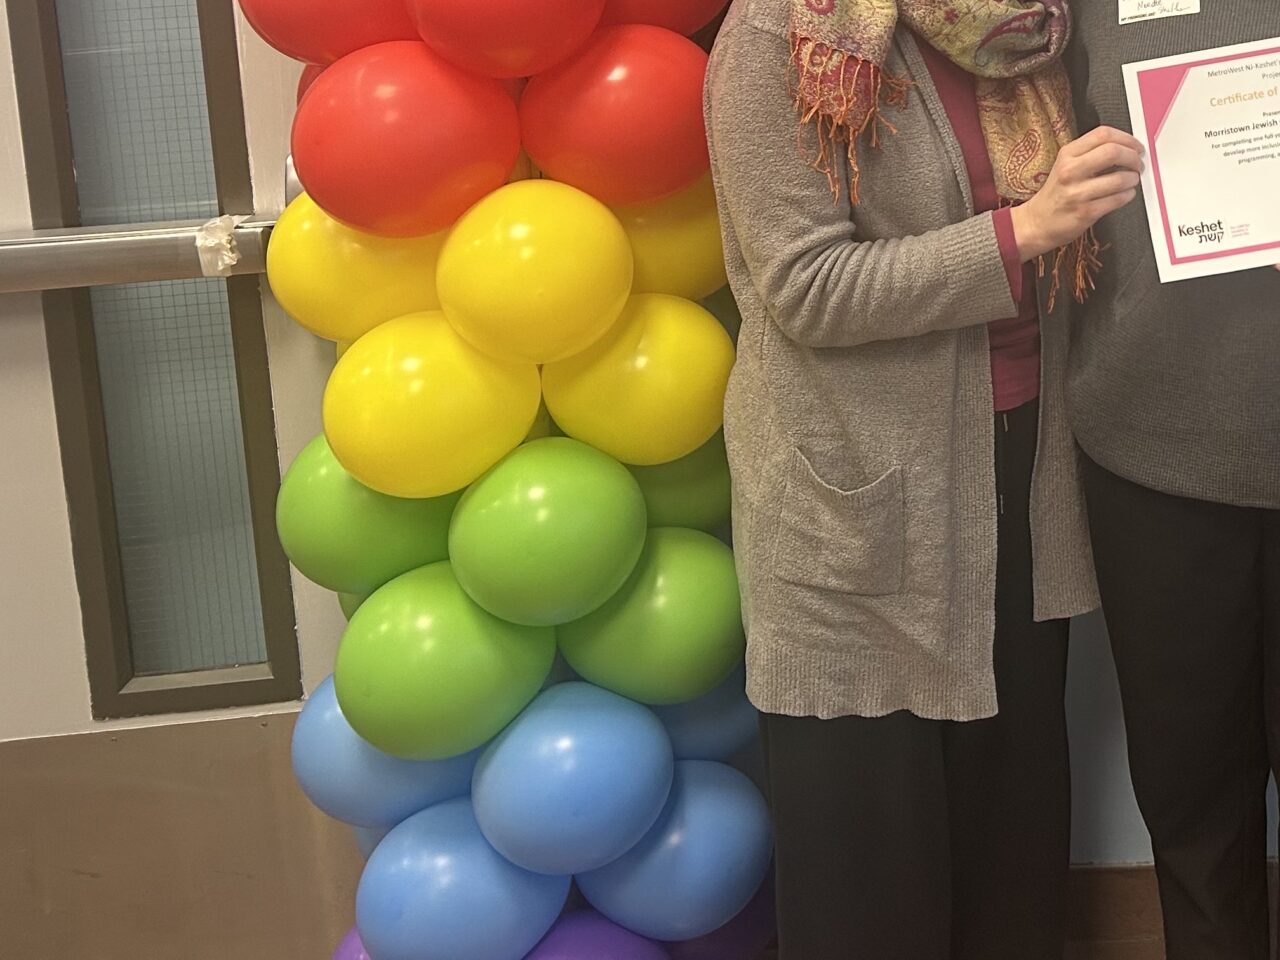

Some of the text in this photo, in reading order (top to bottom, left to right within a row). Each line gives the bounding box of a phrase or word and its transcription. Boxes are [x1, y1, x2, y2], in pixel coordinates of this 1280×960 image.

[1207, 65, 1245, 78] MetroWest
[1209, 90, 1265, 107] Certificate
[1267, 86, 1278, 97] of
[1204, 123, 1251, 138] Morristown
[1251, 119, 1278, 130] Jewish
[1221, 137, 1252, 148] completing
[1264, 133, 1274, 141] full
[1223, 147, 1246, 157] develop
[1238, 152, 1277, 165] programming,
[1178, 219, 1224, 237] Keshet
[1199, 231, 1225, 244] קשת
